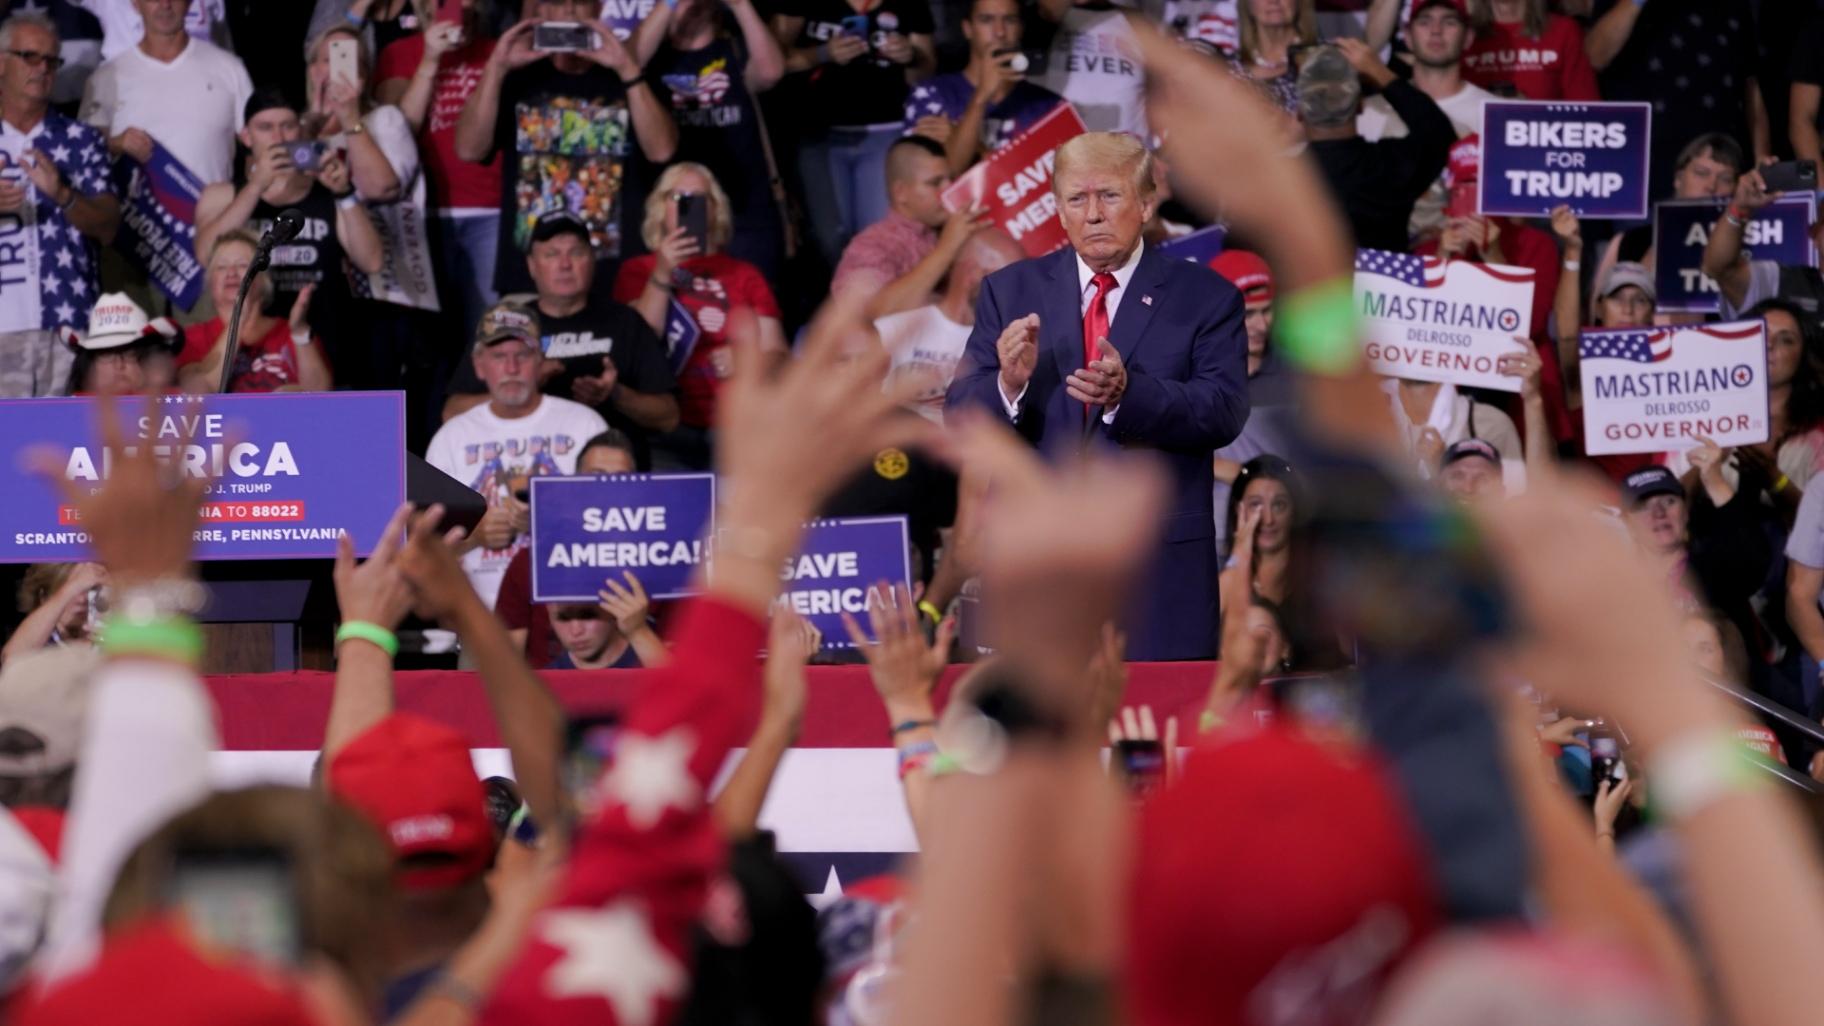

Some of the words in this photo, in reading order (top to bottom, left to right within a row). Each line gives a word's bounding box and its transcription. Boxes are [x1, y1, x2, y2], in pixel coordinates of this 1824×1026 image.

[1065, 55, 1135, 77] EVER
[1464, 48, 1558, 67] TRUMP
[1505, 120, 1627, 149] BIKERS
[1545, 152, 1586, 168] FOR
[1505, 170, 1623, 199] TRUMP
[1684, 219, 1784, 246] ASH
[401, 199, 428, 295] GOVERN
[1362, 290, 1521, 333] MASTRIANO
[1406, 328, 1472, 348] DELROSSO
[1594, 363, 1754, 400] MASTRIANO
[1644, 398, 1711, 417] DELROSSO
[138, 414, 223, 439] SAVE
[1604, 413, 1750, 442] GOVERNOR
[464, 434, 576, 466] TRUMP
[230, 483, 273, 494] TRUMP
[226, 506, 247, 517] TO
[251, 504, 299, 518] 88022
[582, 506, 667, 532] SAVE
[231, 528, 348, 542] PENNSYLVANIA
[546, 540, 702, 568] AMERICA!
